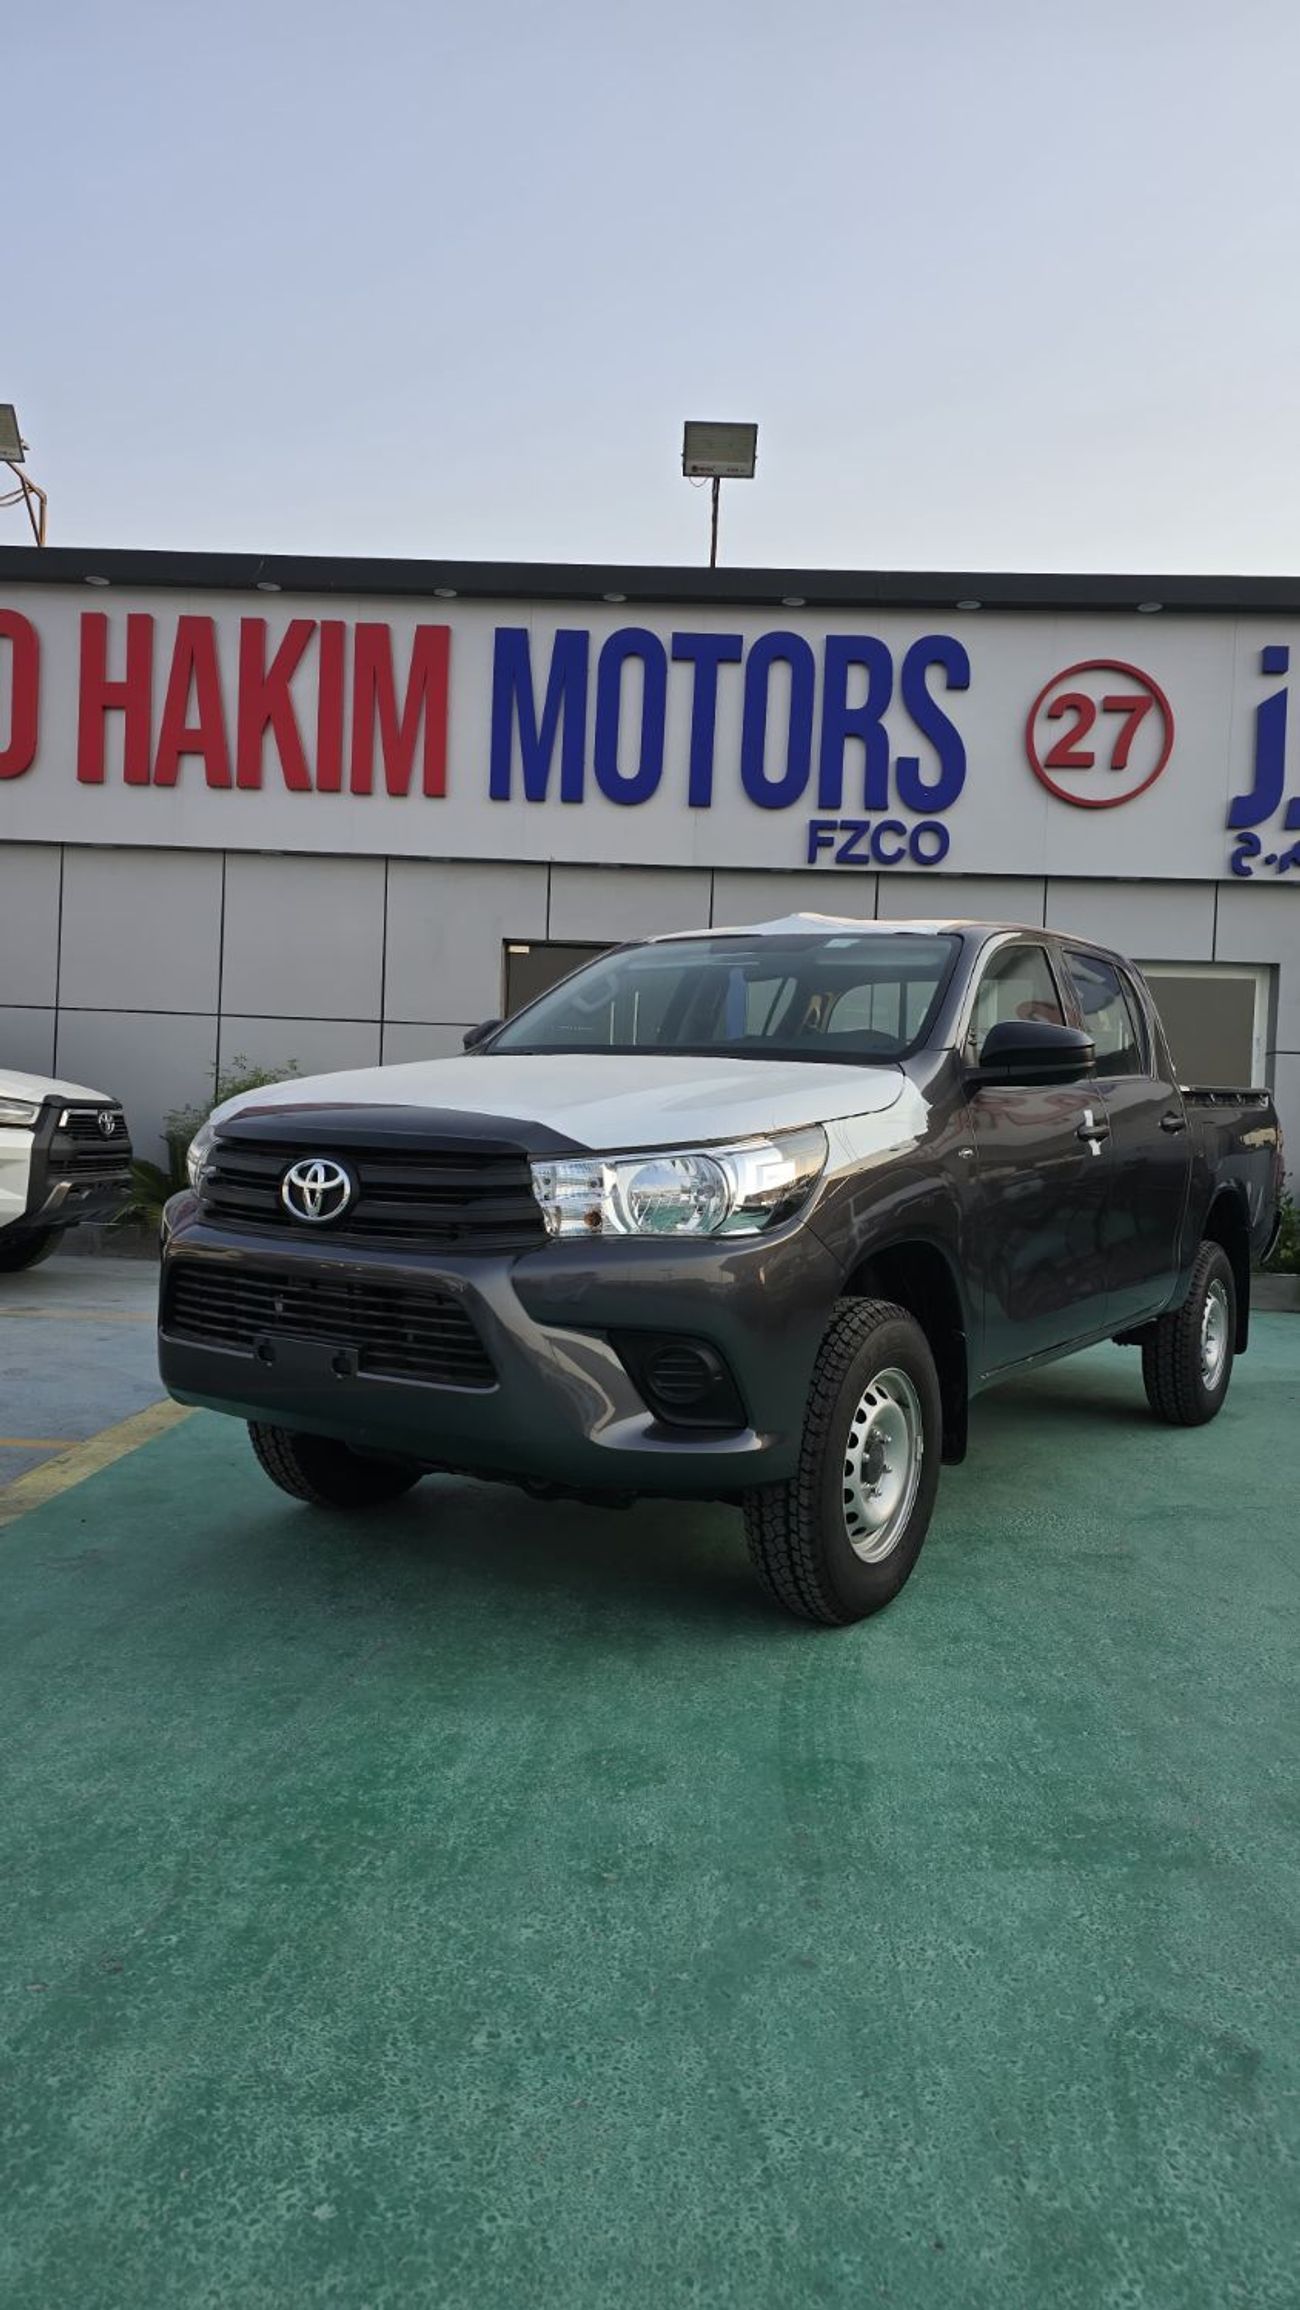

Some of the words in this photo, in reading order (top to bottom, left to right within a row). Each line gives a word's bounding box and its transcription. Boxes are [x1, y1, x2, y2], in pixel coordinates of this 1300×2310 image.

[76, 612, 452, 798] HAKIM
[488, 627, 972, 813] MOTORS
[1044, 692, 1155, 770] 27
[806, 818, 951, 866] FZCO
